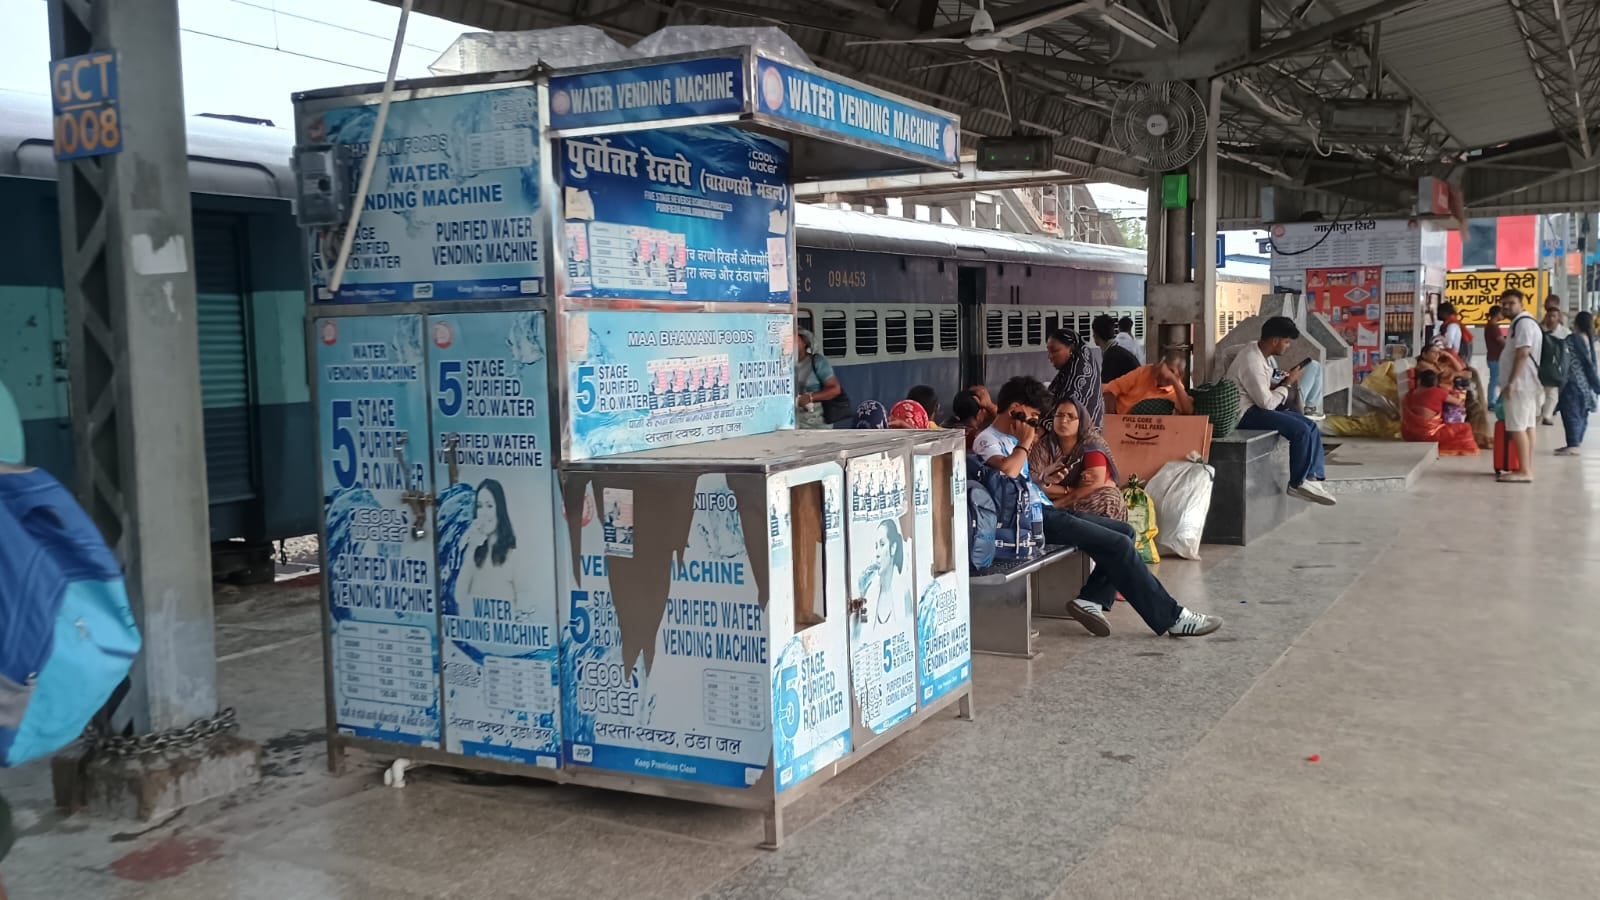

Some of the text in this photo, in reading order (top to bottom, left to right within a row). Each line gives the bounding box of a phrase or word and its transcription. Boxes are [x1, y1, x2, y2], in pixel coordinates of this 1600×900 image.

[53, 54, 113, 103] GCT
[570, 85, 613, 114] WATER
[616, 78, 671, 109] VENDING
[675, 71, 734, 103] MACHINE
[788, 76, 939, 149] WATER VENDING MACHINE
[54, 107, 119, 155] 1008
[403, 134, 448, 154] FOODS
[389, 163, 449, 183] WATER
[641, 146, 692, 187] रेलवे
[422, 184, 503, 207] MACHINE
[436, 217, 532, 243] PURIFIED WATER
[1355, 219, 1377, 232] सिटी
[432, 241, 539, 267] VENDING MACHINE
[719, 264, 734, 280] और
[735, 267, 751, 281] ठंडा
[828, 270, 867, 288] 094453
[1503, 272, 1537, 289] सिटी
[628, 331, 656, 346] MAA
[659, 329, 716, 346] BHAWANI
[718, 329, 754, 344] FOODS
[352, 344, 387, 358] WATER
[328, 365, 417, 380] VENDING MACHINE
[467, 360, 504, 377] STAGE
[599, 368, 629, 380] STAGE
[739, 361, 767, 379] PURIFIED
[438, 362, 462, 416] 5
[467, 380, 520, 396] PURIFIED
[576, 366, 596, 413] 5
[600, 381, 639, 395] PURIFIED
[736, 378, 791, 399] VENDING MACHINE
[358, 399, 395, 427] STAGE
[332, 401, 357, 488] 5
[441, 434, 536, 449] PRIFIED WATER
[487, 451, 542, 467] MACHINE
[339, 556, 428, 584] PURIFIED WATER
[334, 582, 433, 613] VENDING MACHINE
[473, 597, 512, 620] WATER
[569, 590, 590, 643] 5
[667, 598, 761, 631] PURIFIED WATER
[444, 617, 549, 647] VENDING MACHINE
[925, 622, 967, 658] PURIFIED WATER
[662, 628, 766, 663] VENDING MACHINE
[882, 638, 892, 673] 5
[923, 638, 969, 675] VENDING MACHINE
[801, 650, 825, 681] STAGE
[780, 664, 799, 739] 5
[802, 670, 835, 707] PURIFIED
[715, 737, 741, 755] जल
